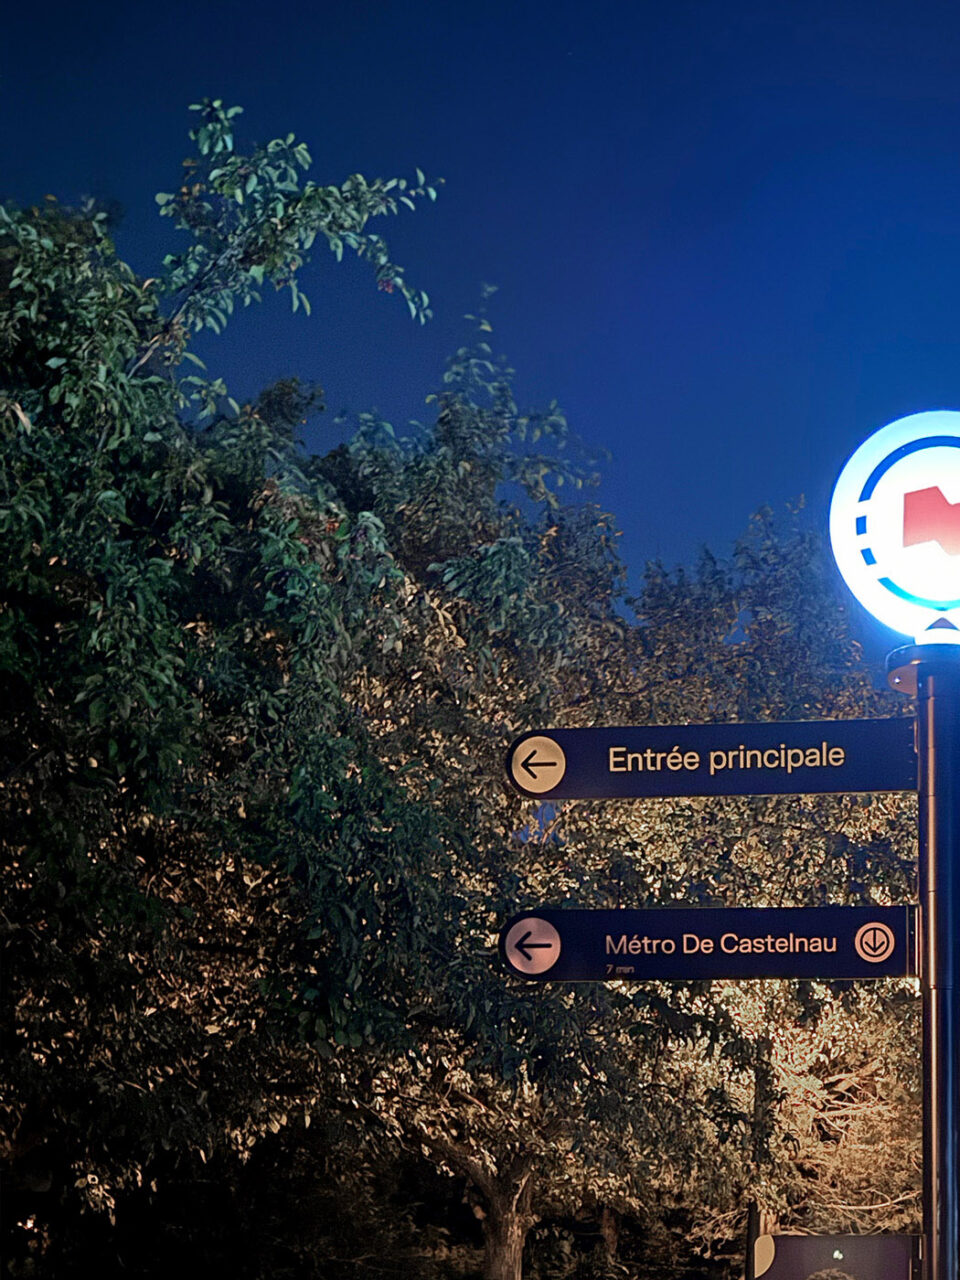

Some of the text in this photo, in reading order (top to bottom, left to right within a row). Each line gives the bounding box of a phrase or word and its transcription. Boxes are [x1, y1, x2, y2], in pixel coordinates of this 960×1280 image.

[608, 741, 845, 775] Entrée principale
[606, 932, 837, 955] Métro De Castelnau
[606, 964, 614, 975] 7
